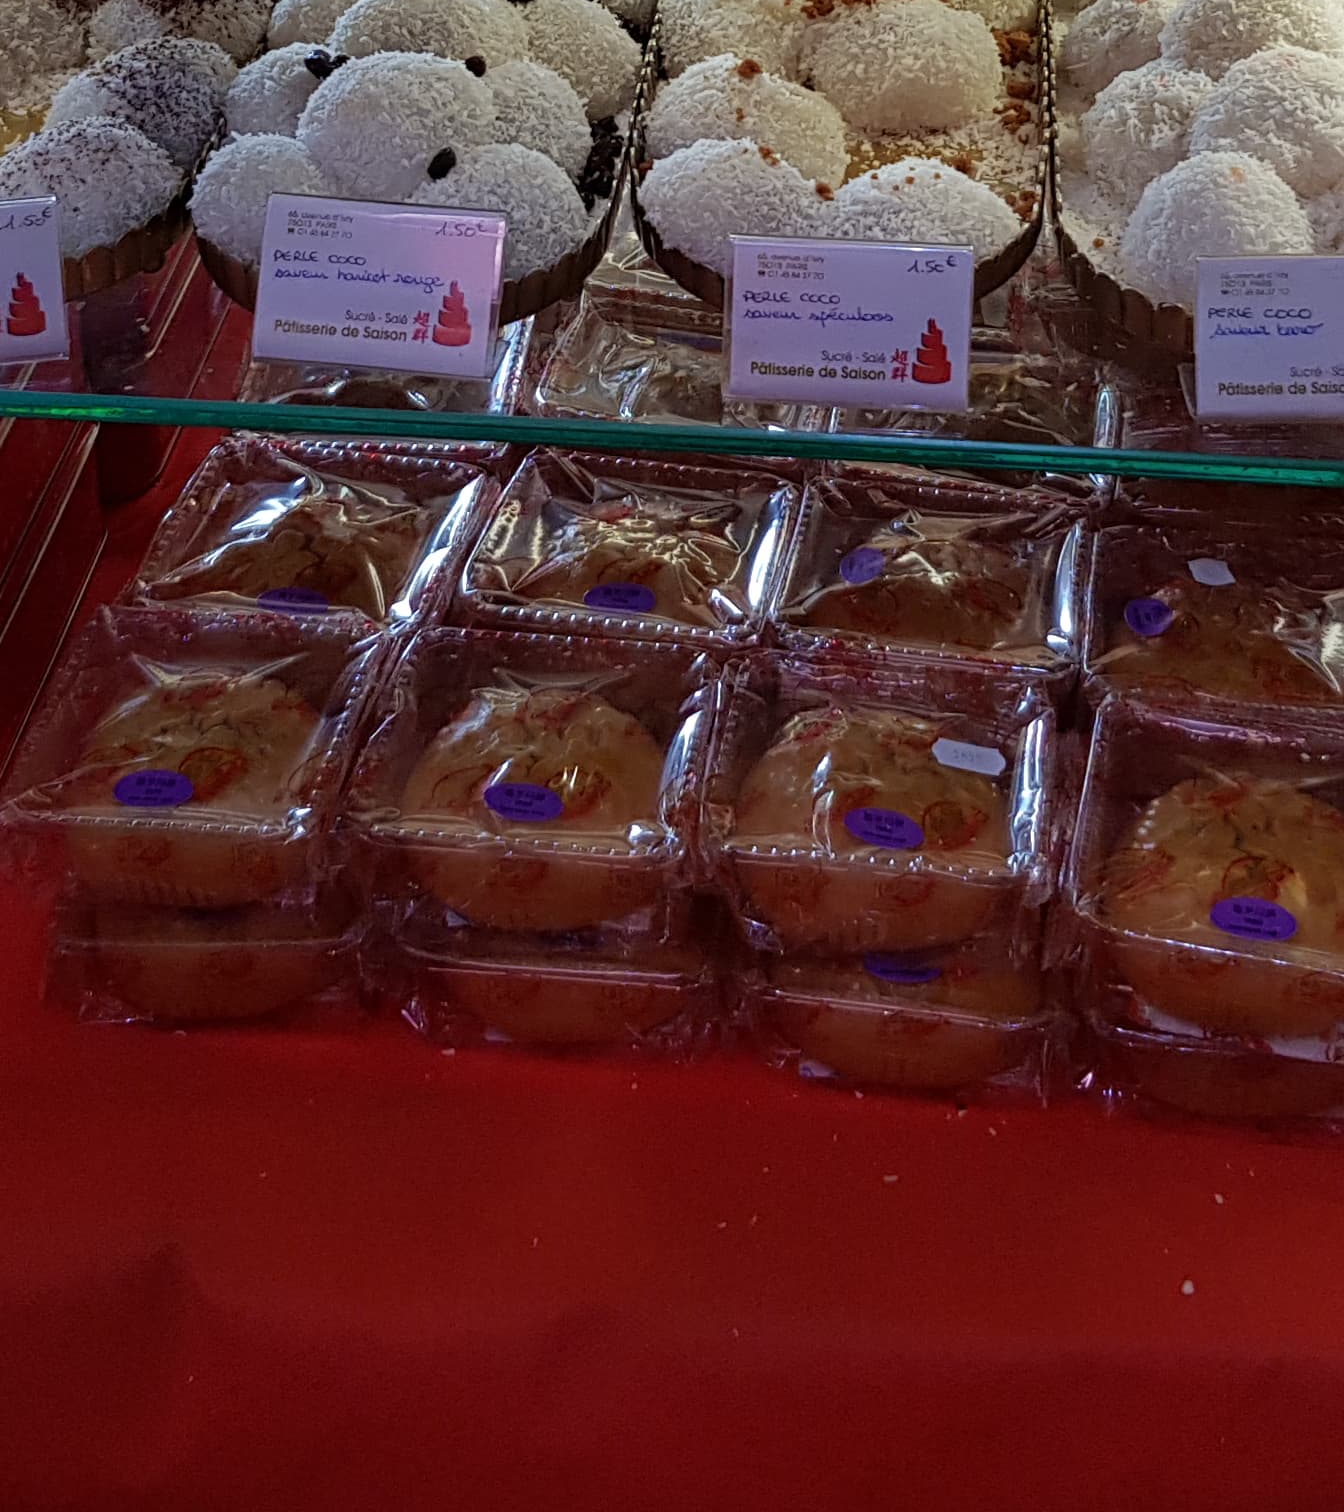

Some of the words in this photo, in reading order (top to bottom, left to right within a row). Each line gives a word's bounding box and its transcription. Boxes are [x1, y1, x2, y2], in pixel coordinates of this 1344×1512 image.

[273, 250, 318, 263] PERLE
[328, 254, 367, 266] COCO
[275, 269, 329, 279] saveur
[337, 268, 388, 284] haricot
[392, 274, 444, 294] rouge
[742, 290, 791, 304] PERLE
[800, 293, 841, 305] COCO
[345, 309, 375, 322] Sucré
[384, 312, 408, 325] Salé
[743, 309, 801, 320] saveur
[808, 306, 894, 328] spéculoos
[1208, 307, 1253, 320] PERLE
[1264, 307, 1312, 320] COCO
[275, 319, 336, 336] Pâtisserie
[341, 326, 359, 337] de
[363, 328, 407, 342] Saison
[822, 350, 853, 362] Sucré
[863, 351, 887, 363] Salé
[751, 361, 814, 377] Pâtisserie
[819, 364, 837, 378] de
[841, 366, 886, 381] Saison
[1289, 366, 1321, 378] Sucré
[1218, 382, 1282, 396] Pâtisserie
[1288, 383, 1306, 395] de
